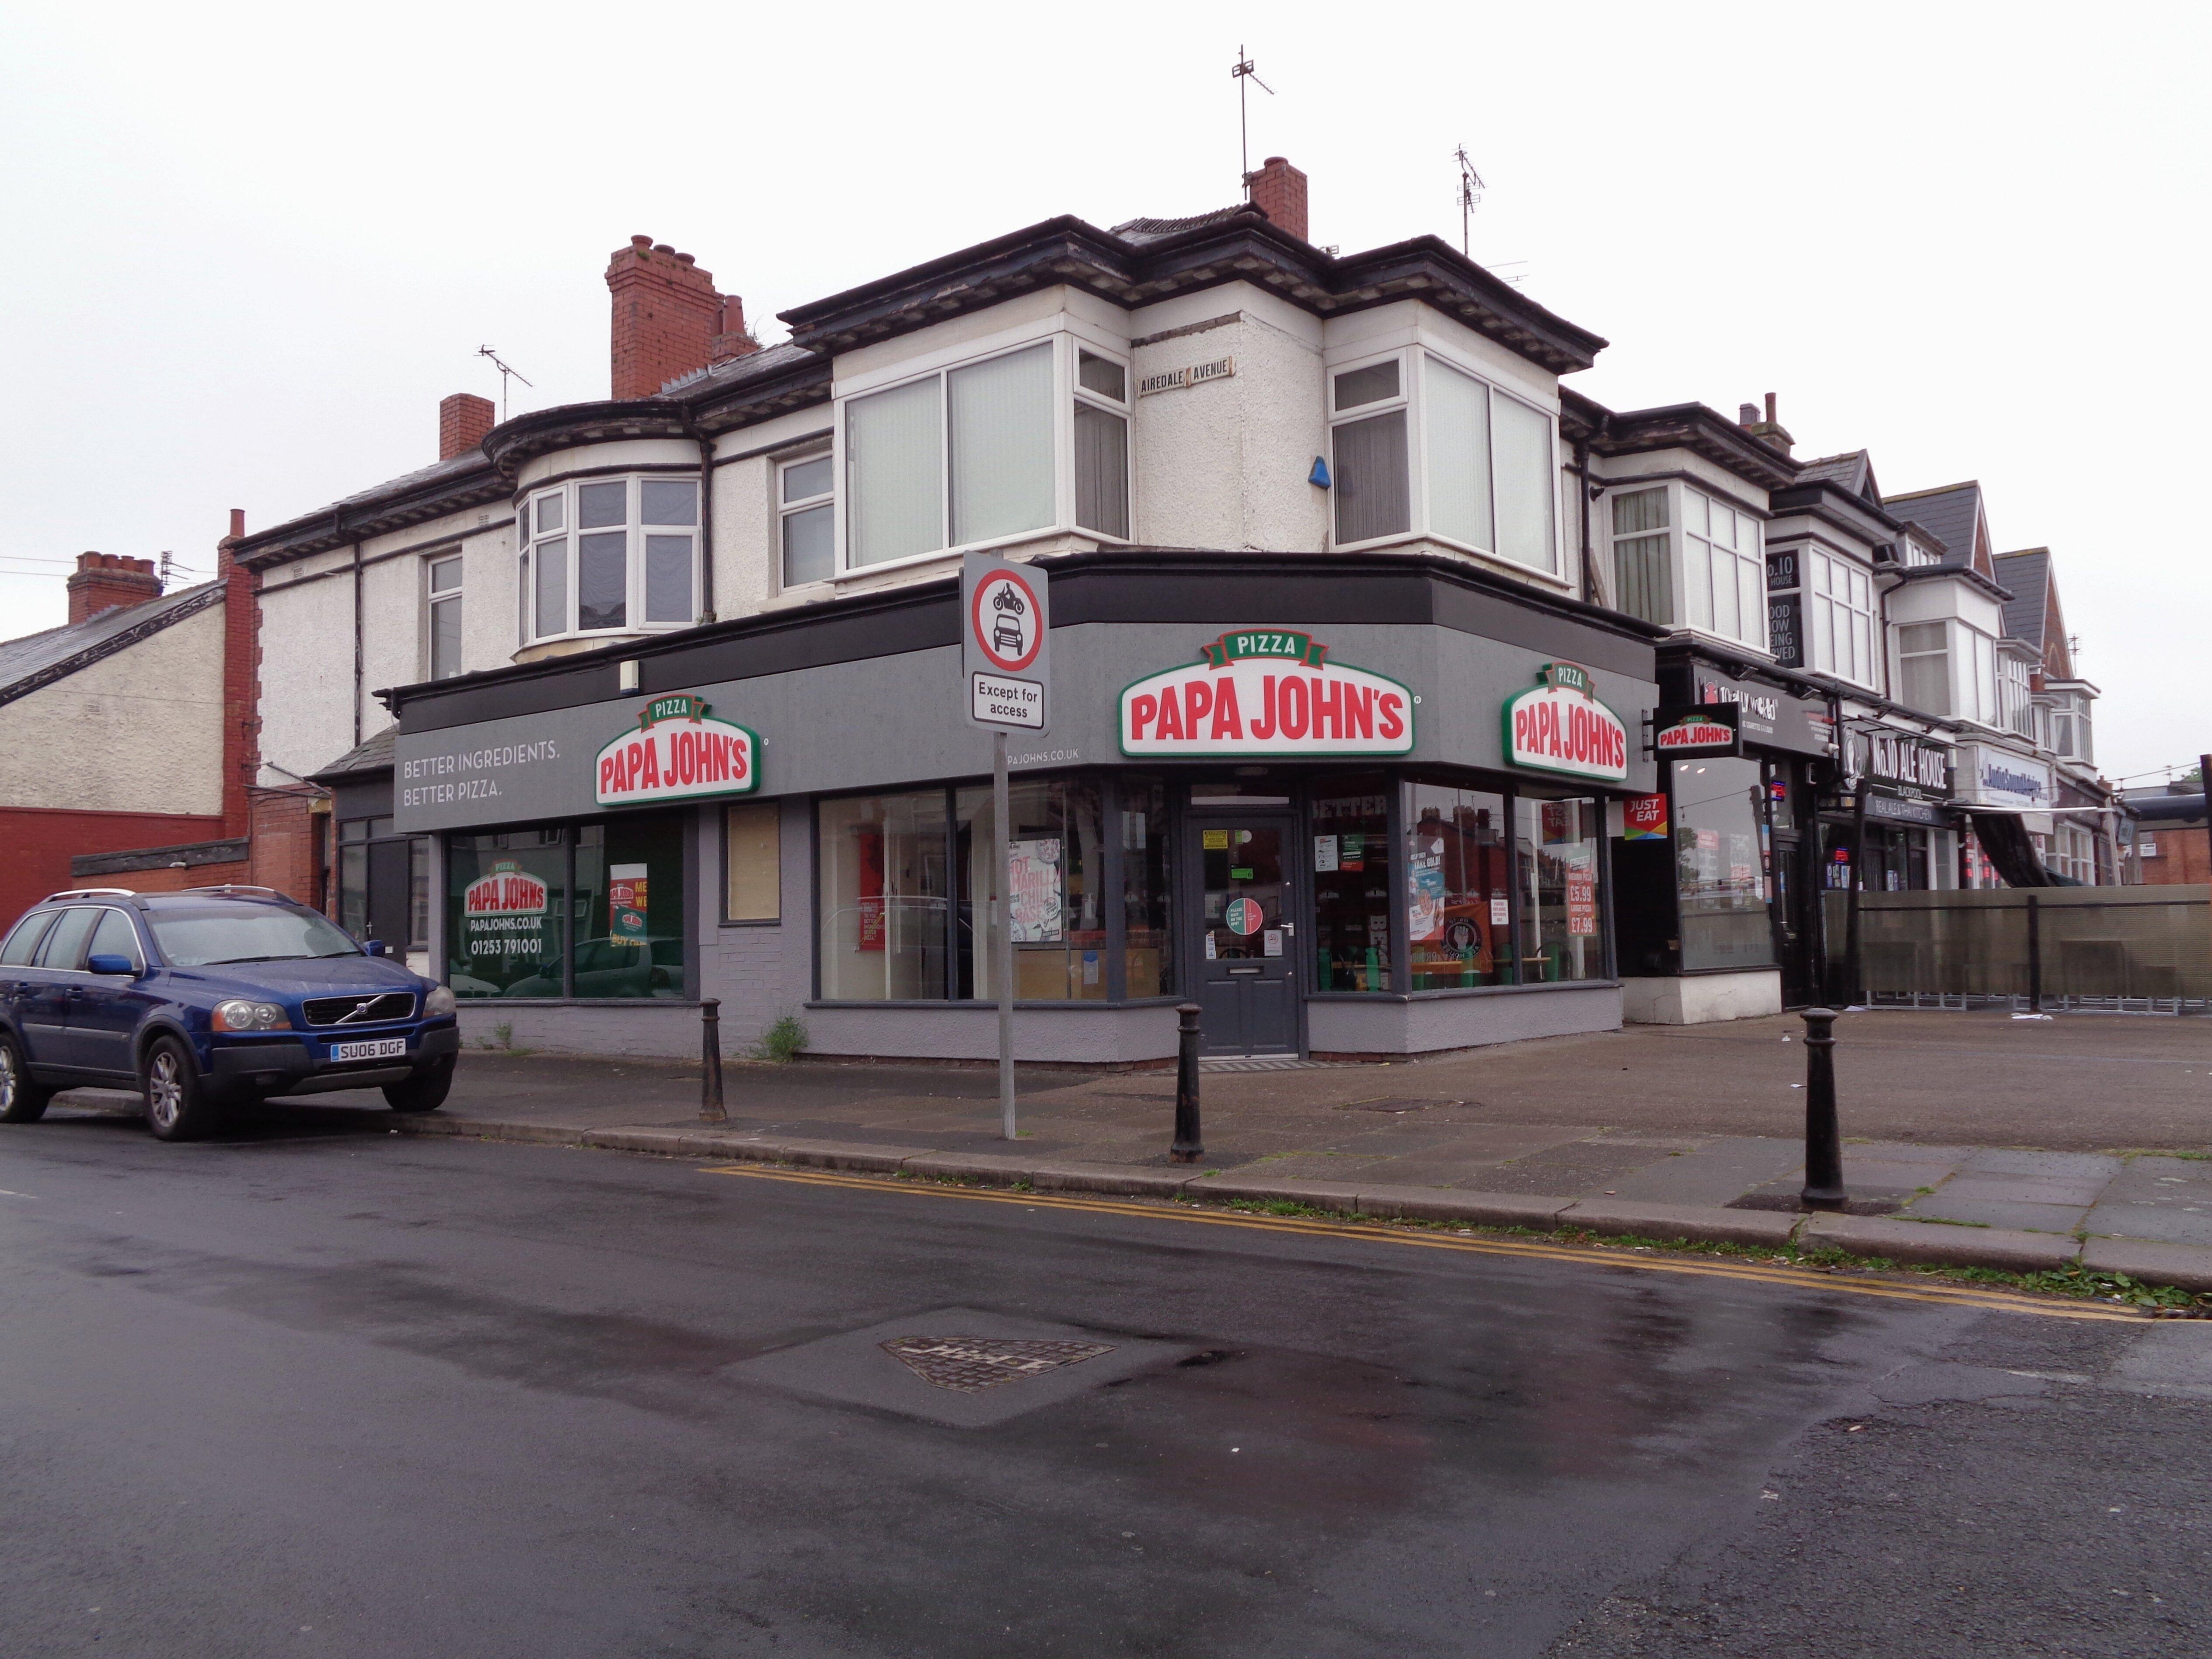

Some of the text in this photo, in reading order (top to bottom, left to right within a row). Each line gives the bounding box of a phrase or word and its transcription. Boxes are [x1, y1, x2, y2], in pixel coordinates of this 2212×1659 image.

[1141, 359, 1227, 392] AIREDALE AVENUE
[1772, 575, 1793, 586] HOUSE
[1769, 605, 1790, 620] OOD
[1769, 618, 1789, 633] OW
[1237, 635, 1296, 654] PIZZA
[1770, 632, 1792, 647] EING
[1771, 646, 1795, 660] RVED
[1558, 667, 1582, 688] PIZZA
[979, 681, 1038, 702] Except for
[655, 698, 687, 718] PIZZA
[990, 703, 1028, 718] access
[1131, 675, 1404, 740] PAPA JOHN'S
[1516, 701, 1624, 769] PAPA JOHN'S
[1661, 726, 1730, 746] PAPA JOHN'S
[404, 739, 560, 779] BETTER INGREDIENTS.
[600, 731, 747, 794] PAPA JOHN'S
[1901, 742, 1917, 783] ALE
[1919, 747, 1947, 789] HOUSE
[404, 779, 502, 807] BETTER PIZZA.
[1898, 785, 1923, 800] BLACKPOOL
[1630, 798, 1659, 813] JUST
[1876, 800, 1888, 814] REAL
[1636, 810, 1659, 822] EAT
[495, 862, 515, 871] PIZZA
[468, 879, 499, 911] PAPA
[1570, 885, 1591, 902] £5.99
[1016, 904, 1043, 924] BASE
[471, 917, 542, 932] PAPAJOHNS.CO.UK
[1571, 917, 1593, 933] £7.99
[471, 938, 542, 955] 01253 791001
[341, 1041, 404, 1058] SU06 DGF
